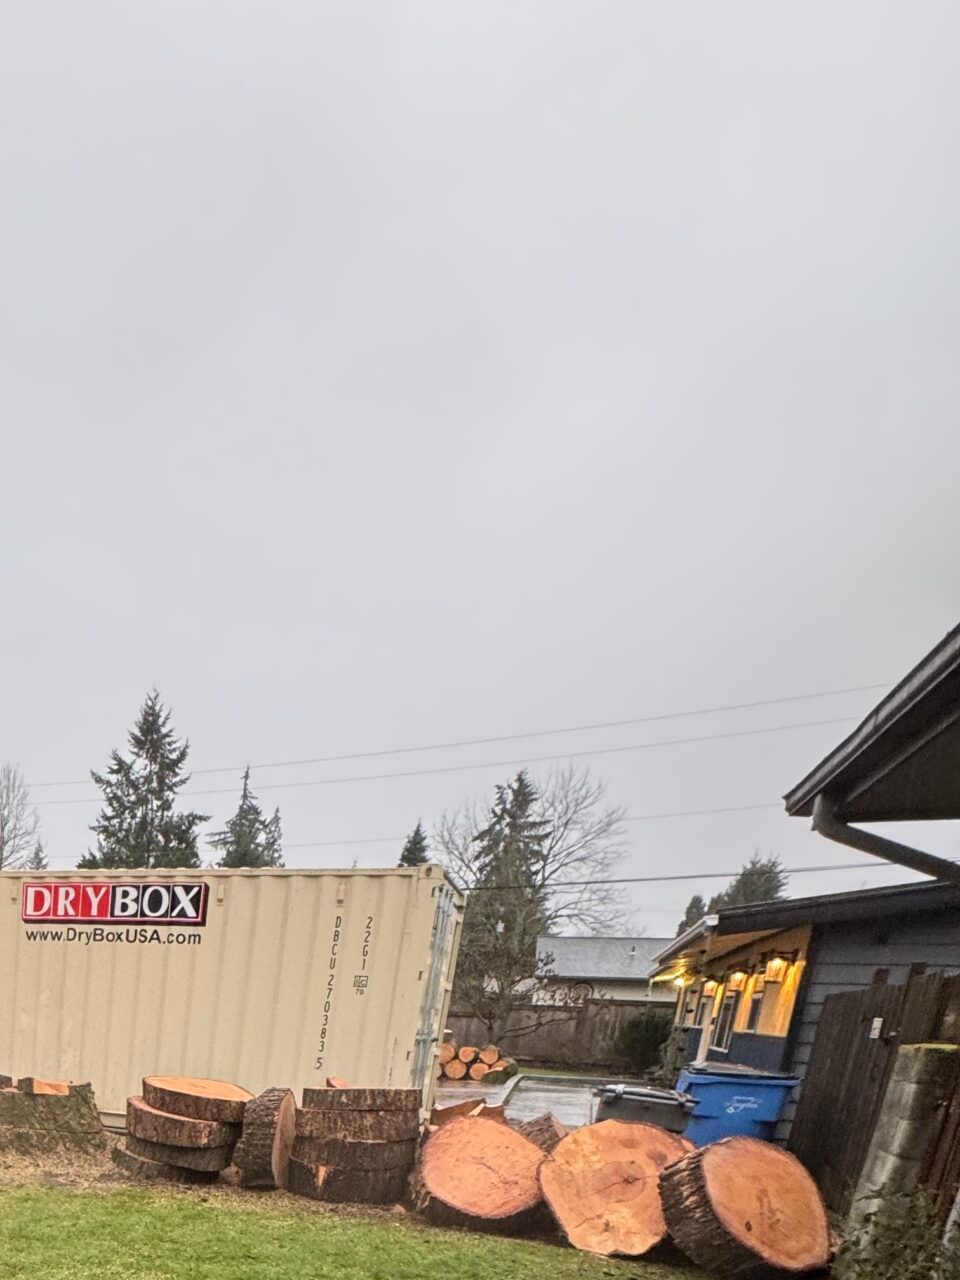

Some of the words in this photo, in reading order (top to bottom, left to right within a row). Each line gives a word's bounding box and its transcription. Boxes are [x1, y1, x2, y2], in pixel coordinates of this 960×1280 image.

[25, 886, 199, 917] DRYBOX
[25, 928, 201, 945] www.DryBoxUSA.com
[329, 916, 341, 969] DBCU
[362, 916, 373, 970] 22G1
[318, 974, 334, 1052] 270383
[315, 1057, 323, 1070] 5
